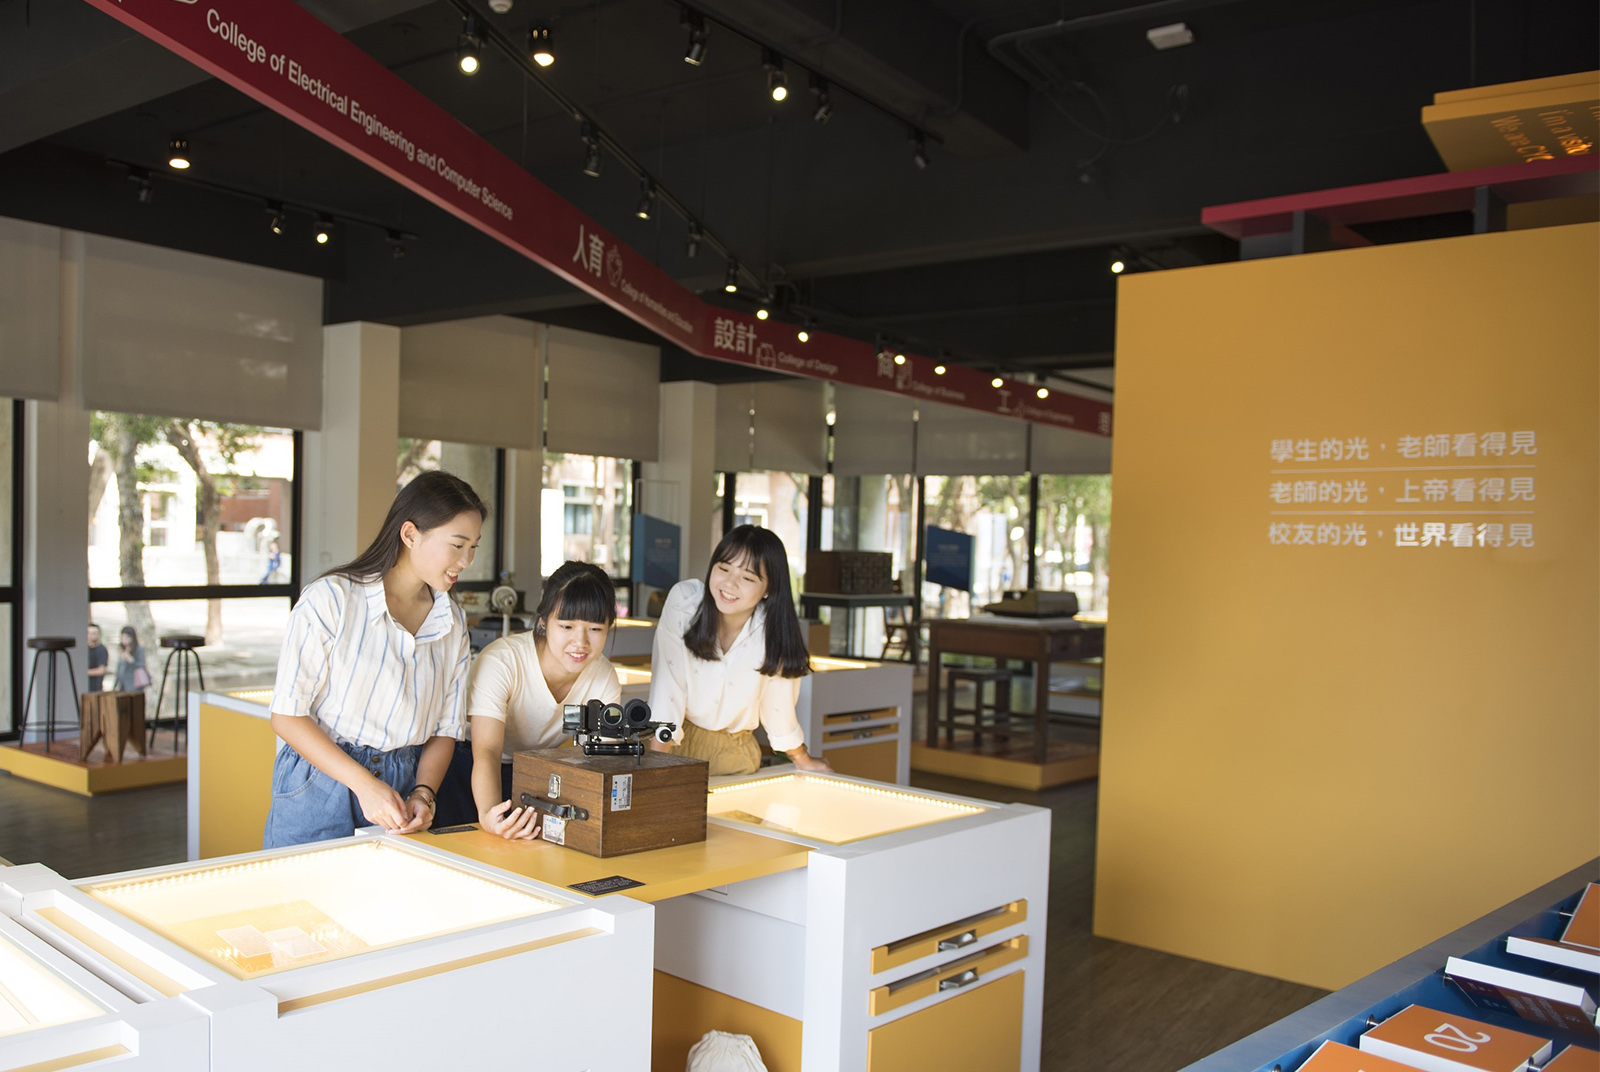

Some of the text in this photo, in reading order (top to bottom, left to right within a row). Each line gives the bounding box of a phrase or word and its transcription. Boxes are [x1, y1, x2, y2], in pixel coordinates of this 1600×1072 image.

[207, 8, 513, 220] College of Electrical Engineering and Computer Science
[573, 224, 604, 278] 人育
[713, 316, 757, 356] 設計
[778, 351, 806, 369] College
[815, 359, 839, 376] Design
[1424, 1022, 1491, 1052] 20
